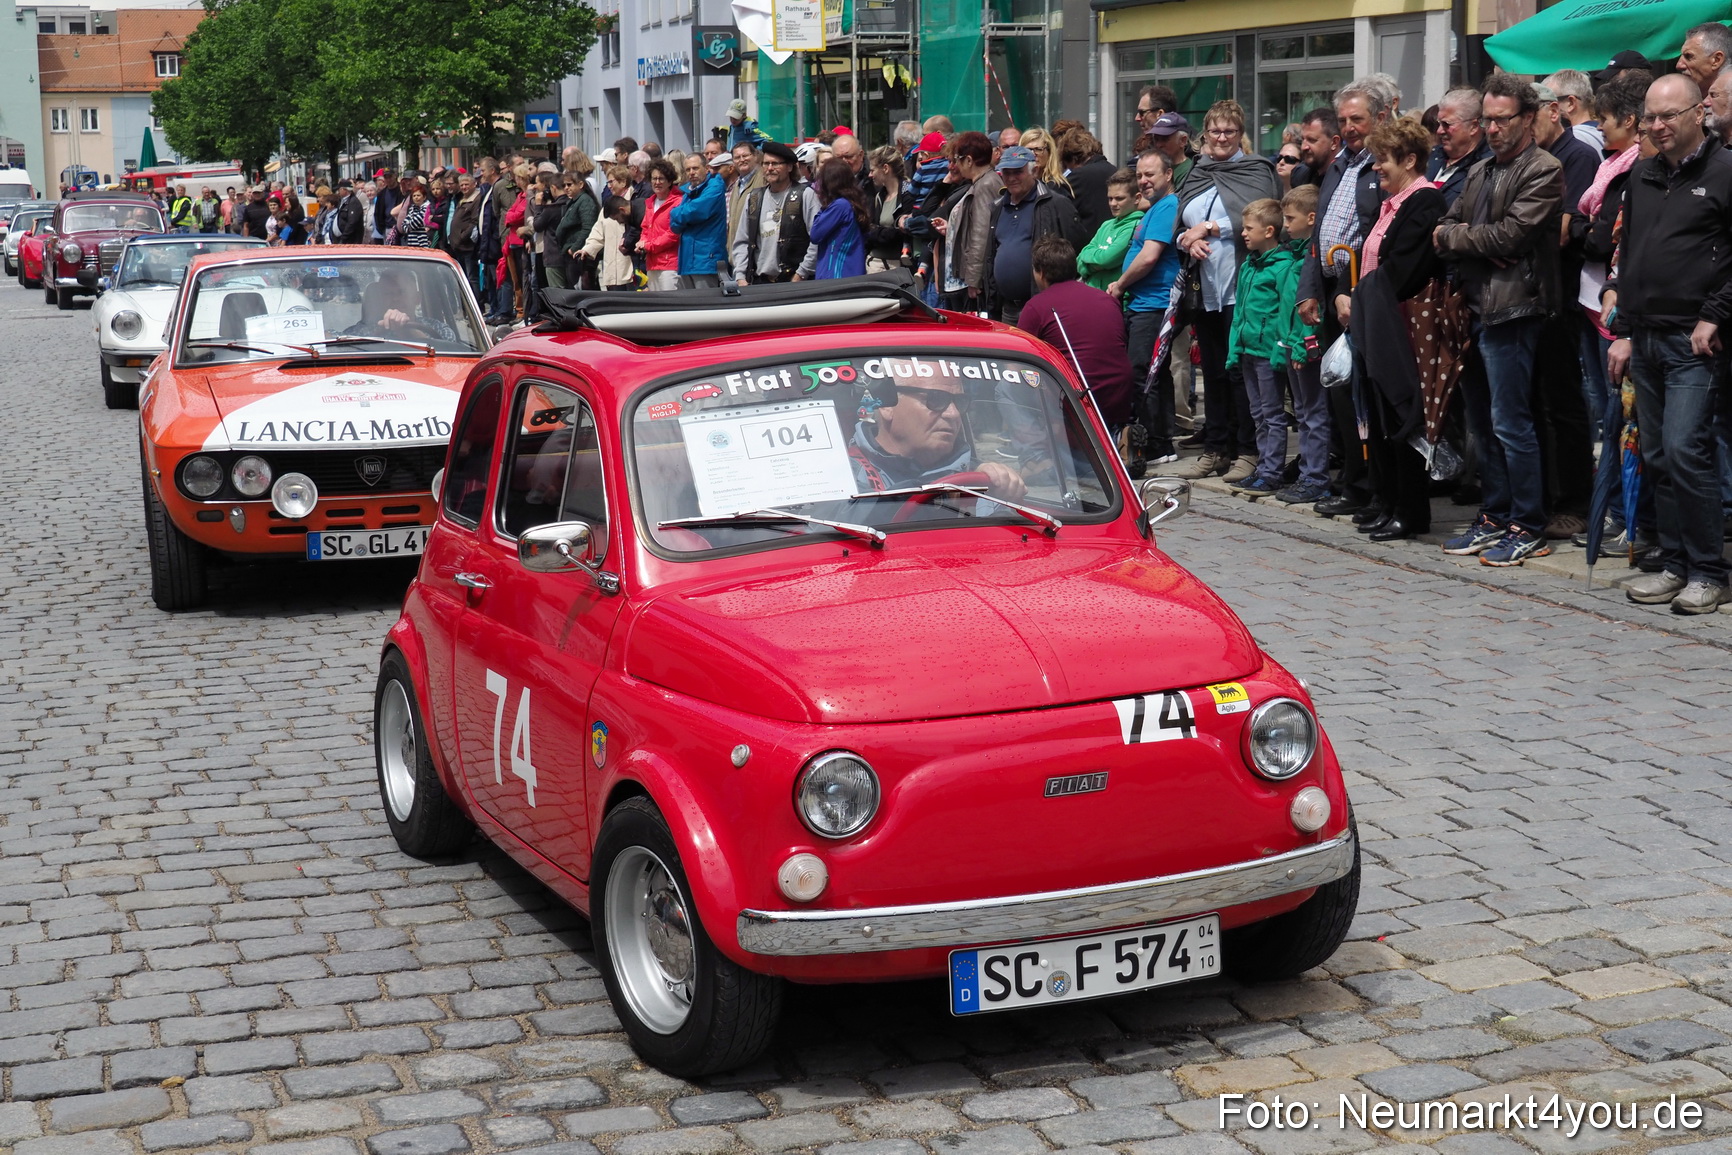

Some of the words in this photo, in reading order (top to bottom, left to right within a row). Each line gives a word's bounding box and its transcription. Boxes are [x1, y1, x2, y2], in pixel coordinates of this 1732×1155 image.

[709, 39, 727, 59] G2
[283, 319, 308, 329] 263
[726, 369, 792, 396] Fiat
[800, 360, 858, 394] 500
[863, 357, 934, 380] Club
[941, 360, 1022, 385] Italia
[651, 403, 673, 411] 1000
[651, 409, 677, 418] MIGLIA
[237, 416, 452, 442] LANCIA-Marlb
[761, 423, 813, 448] 104
[323, 535, 353, 556] SC
[369, 533, 399, 555] GL
[1112, 690, 1197, 744] 74
[1222, 704, 1235, 712] Agip
[486, 668, 537, 808] 74
[1049, 774, 1106, 794] FIAT
[1199, 923, 1213, 937] 04
[983, 951, 1042, 1002] SC
[1075, 943, 1102, 991] F
[1115, 928, 1191, 984] 574
[1200, 955, 1214, 969] 10
[961, 988, 971, 1002] D
